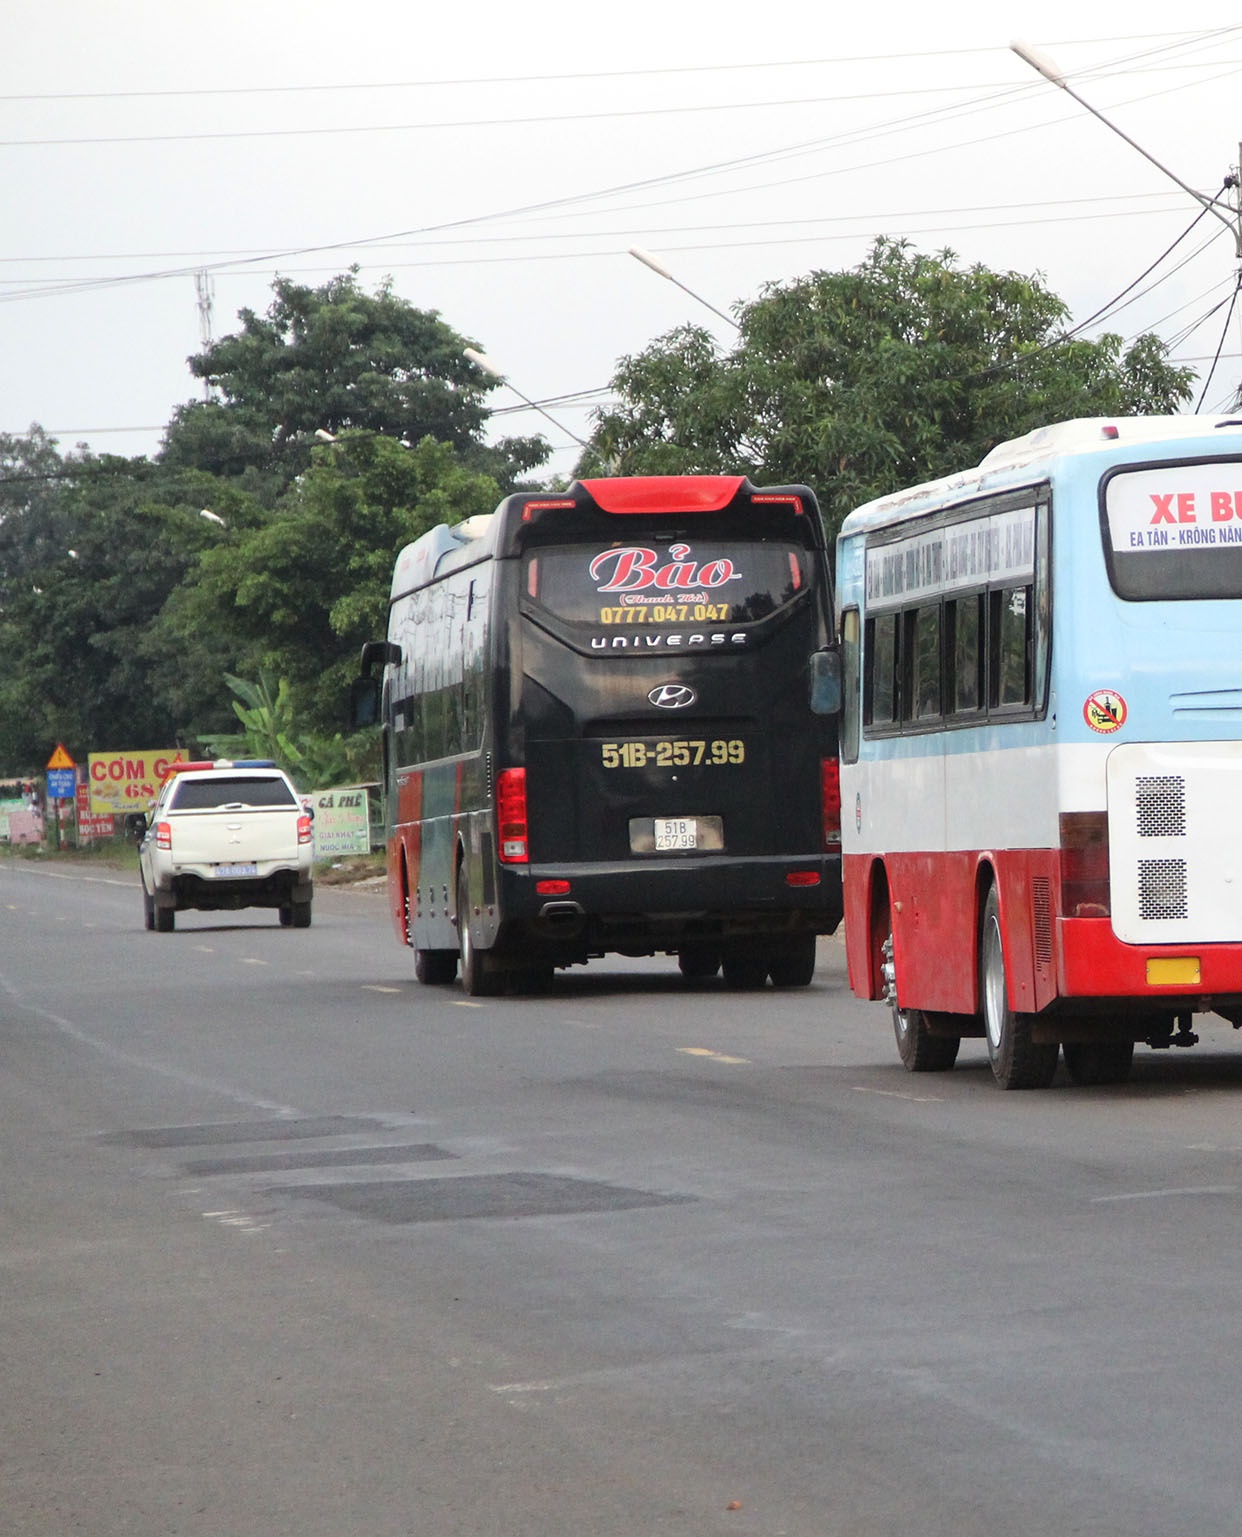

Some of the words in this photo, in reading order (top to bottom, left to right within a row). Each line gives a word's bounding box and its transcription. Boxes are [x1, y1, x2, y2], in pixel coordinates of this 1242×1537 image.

[1149, 493, 1198, 525] XE
[1130, 532, 1144, 547] EA
[1148, 529, 1168, 546] TÂN
[1179, 525, 1216, 545] KRÔNG
[589, 543, 742, 592] Bảo
[600, 603, 730, 624] 0777.047.047
[591, 633, 747, 648] UNIVERSE
[602, 740, 745, 769] 51B-257.99
[91, 756, 145, 781] CƠM
[665, 822, 687, 834] 51B
[657, 835, 695, 848] 257.99
